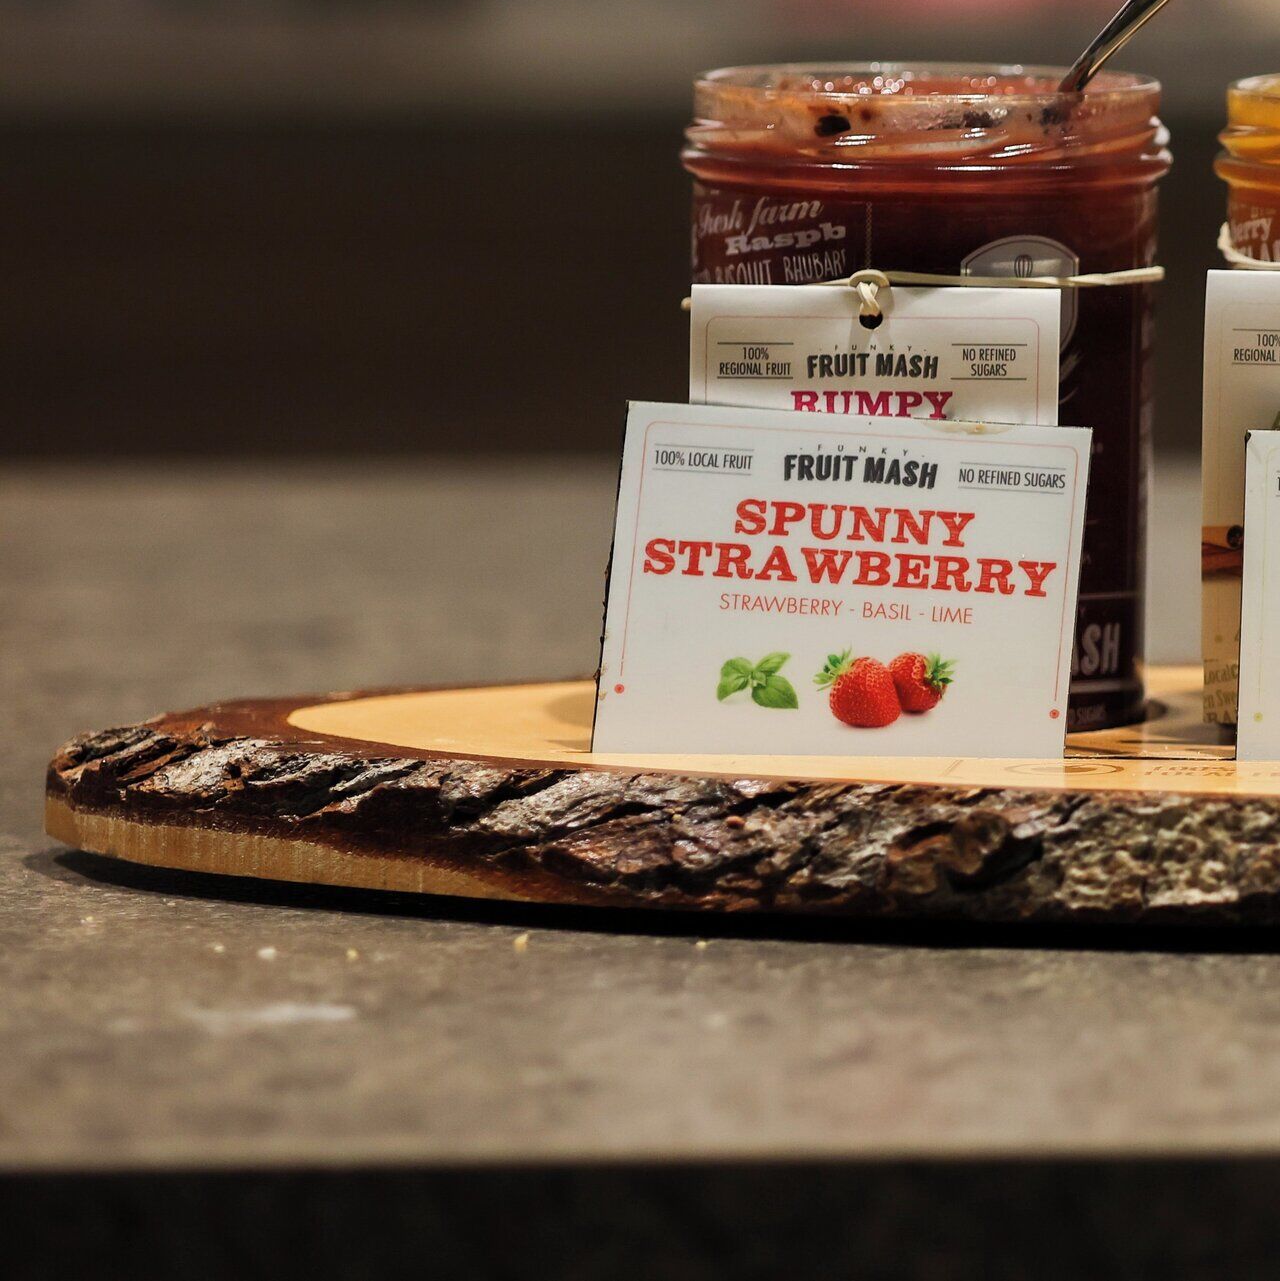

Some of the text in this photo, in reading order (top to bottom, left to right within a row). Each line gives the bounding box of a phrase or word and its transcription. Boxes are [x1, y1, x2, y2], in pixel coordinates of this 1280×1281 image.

[719, 347, 791, 376] 100% REGIONAL FRUIT
[806, 353, 939, 379] FRUIT MASH
[962, 348, 1016, 362] NO REFINED
[1233, 348, 1276, 362] REGIONAL
[970, 363, 1007, 377] SUGARS
[654, 450, 753, 471] 100% LOCAL FRUIT
[818, 444, 909, 456] FUNKY
[784, 453, 938, 489] FRUIT MASH
[958, 468, 1066, 489] NO REFINED SUGARS
[734, 498, 975, 547] SPUNNY
[643, 538, 1057, 597] STRAWBERRY
[720, 593, 973, 625] STRAWBERRY BASIL LIME
